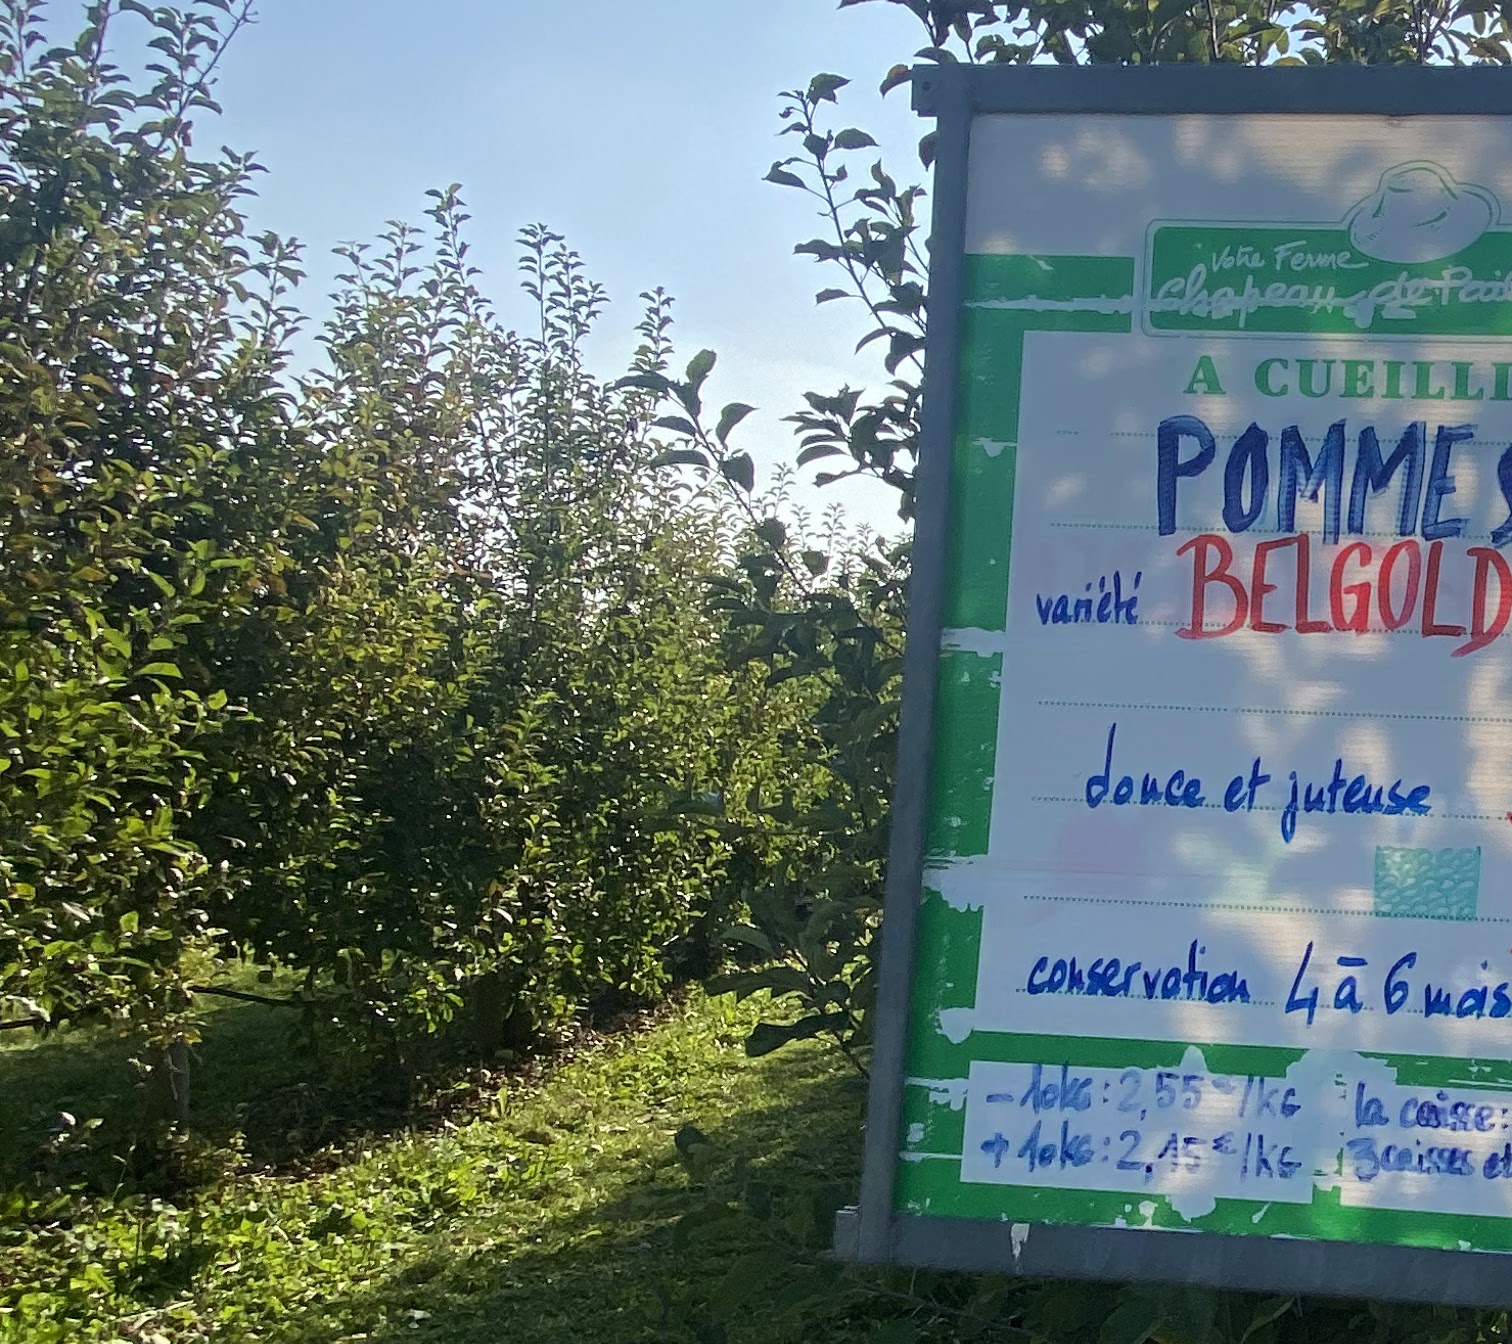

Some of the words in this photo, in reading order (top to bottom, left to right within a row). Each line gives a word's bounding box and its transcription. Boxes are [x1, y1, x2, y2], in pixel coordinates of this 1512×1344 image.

[1274, 239, 1370, 272] Ferme
[1183, 355, 1227, 396] A
[1036, 569, 1142, 625] variété
[1084, 722, 1206, 809] douce
[1223, 756, 1270, 812] et
[1280, 757, 1432, 843] juteuse
[1026, 938, 1252, 1005] conservation
[1284, 940, 1320, 1026] 4
[1383, 951, 1418, 1016] 6
[1424, 959, 1512, 1020] mois
[1355, 1080, 1390, 1128] la
